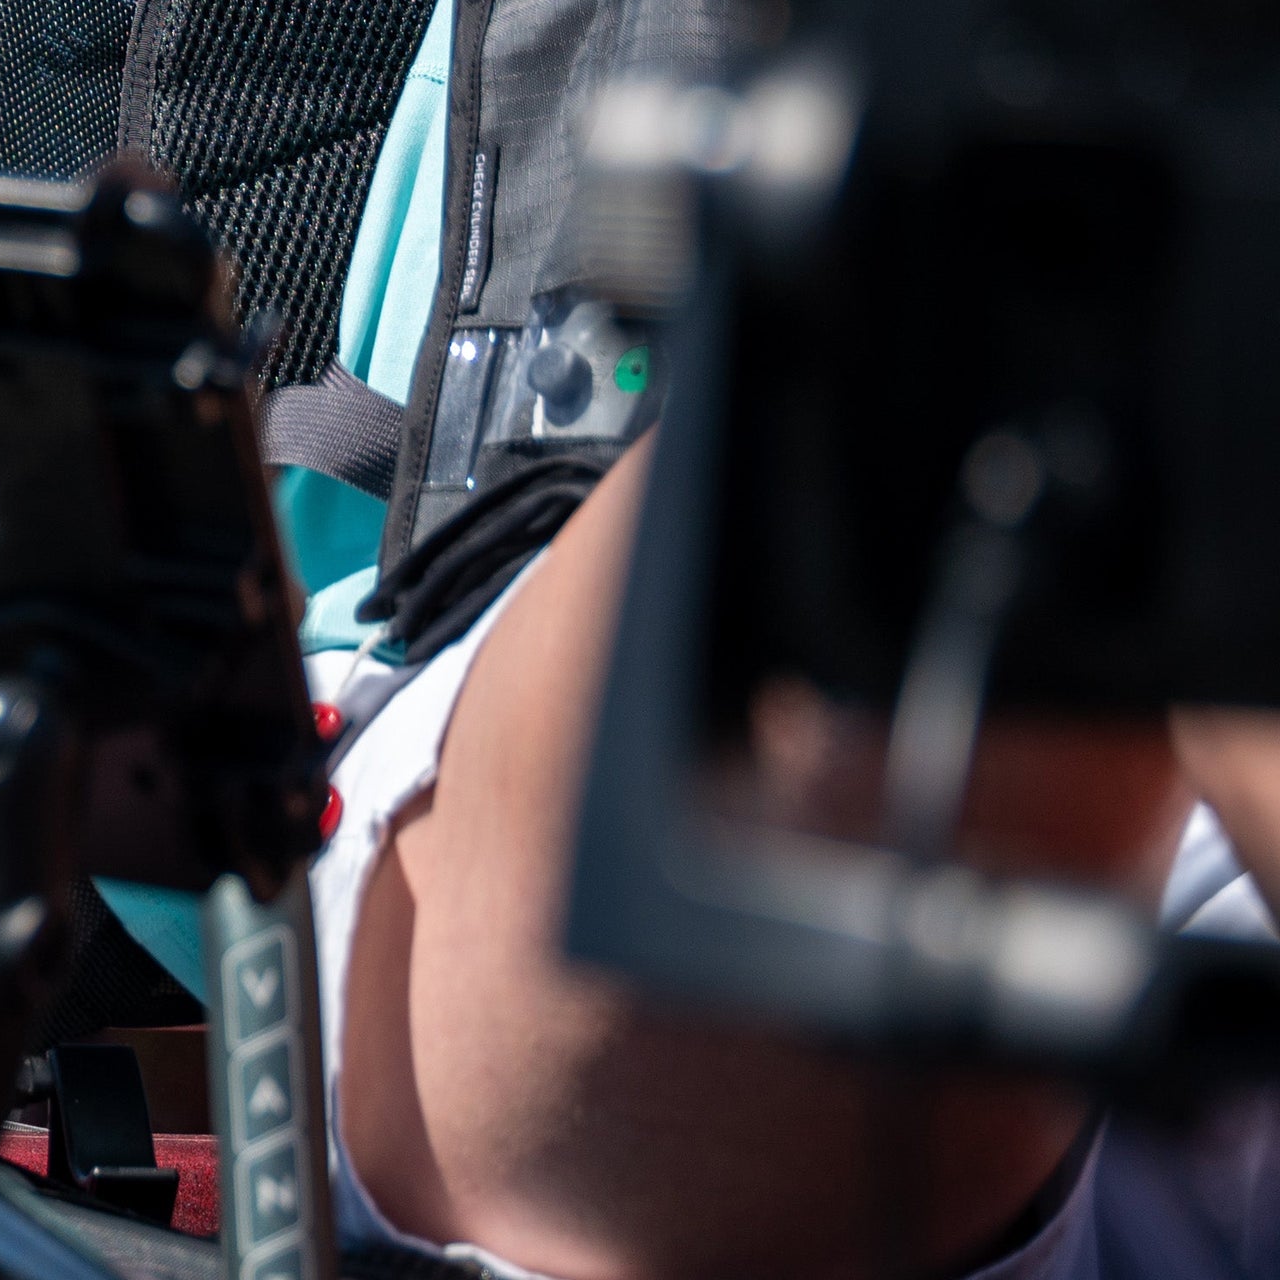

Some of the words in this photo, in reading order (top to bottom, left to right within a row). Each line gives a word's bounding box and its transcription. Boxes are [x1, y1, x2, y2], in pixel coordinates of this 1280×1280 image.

[473, 153, 486, 197] CHECK
[467, 201, 482, 266] CYLINDER
[460, 268, 475, 301] SEAL
